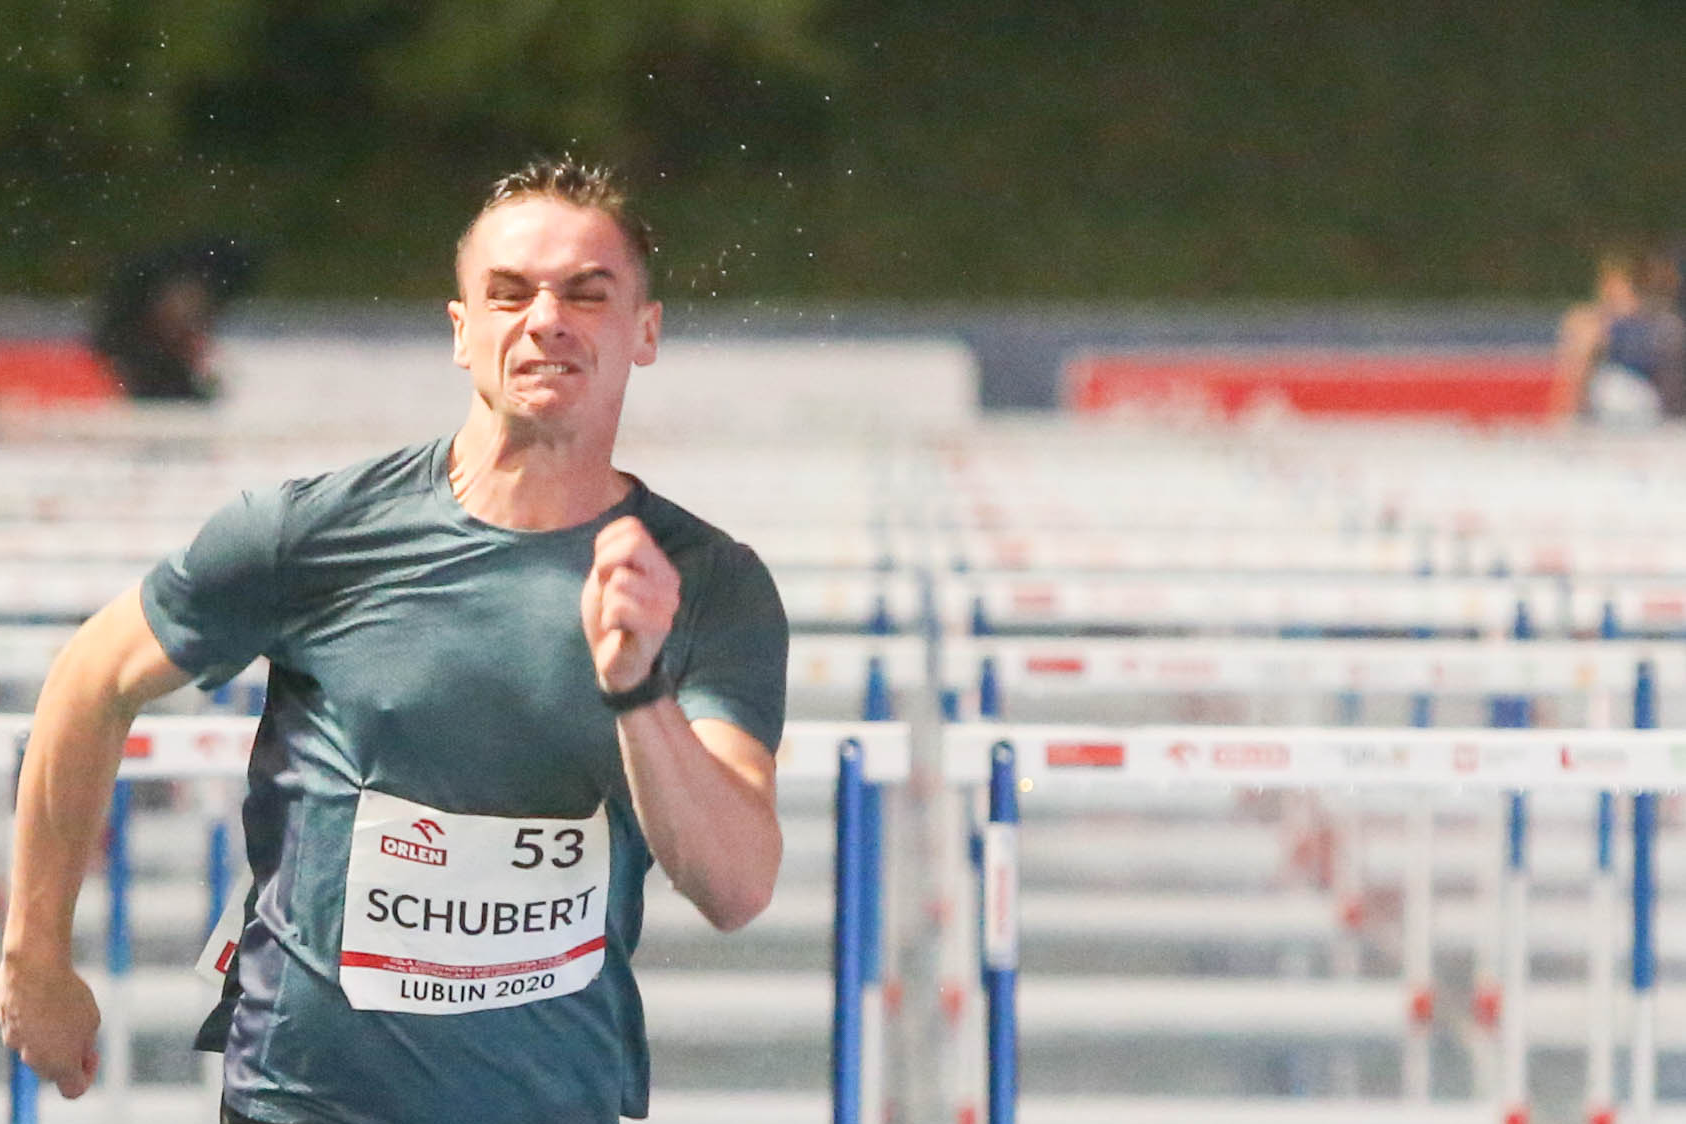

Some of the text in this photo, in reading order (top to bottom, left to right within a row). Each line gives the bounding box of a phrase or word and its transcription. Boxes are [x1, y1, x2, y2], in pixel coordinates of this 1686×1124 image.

[382, 837, 445, 866] ORLEN
[511, 827, 585, 870] 53
[366, 885, 597, 936] SCHUBERT
[400, 973, 555, 1003] LUBLIN 2020
